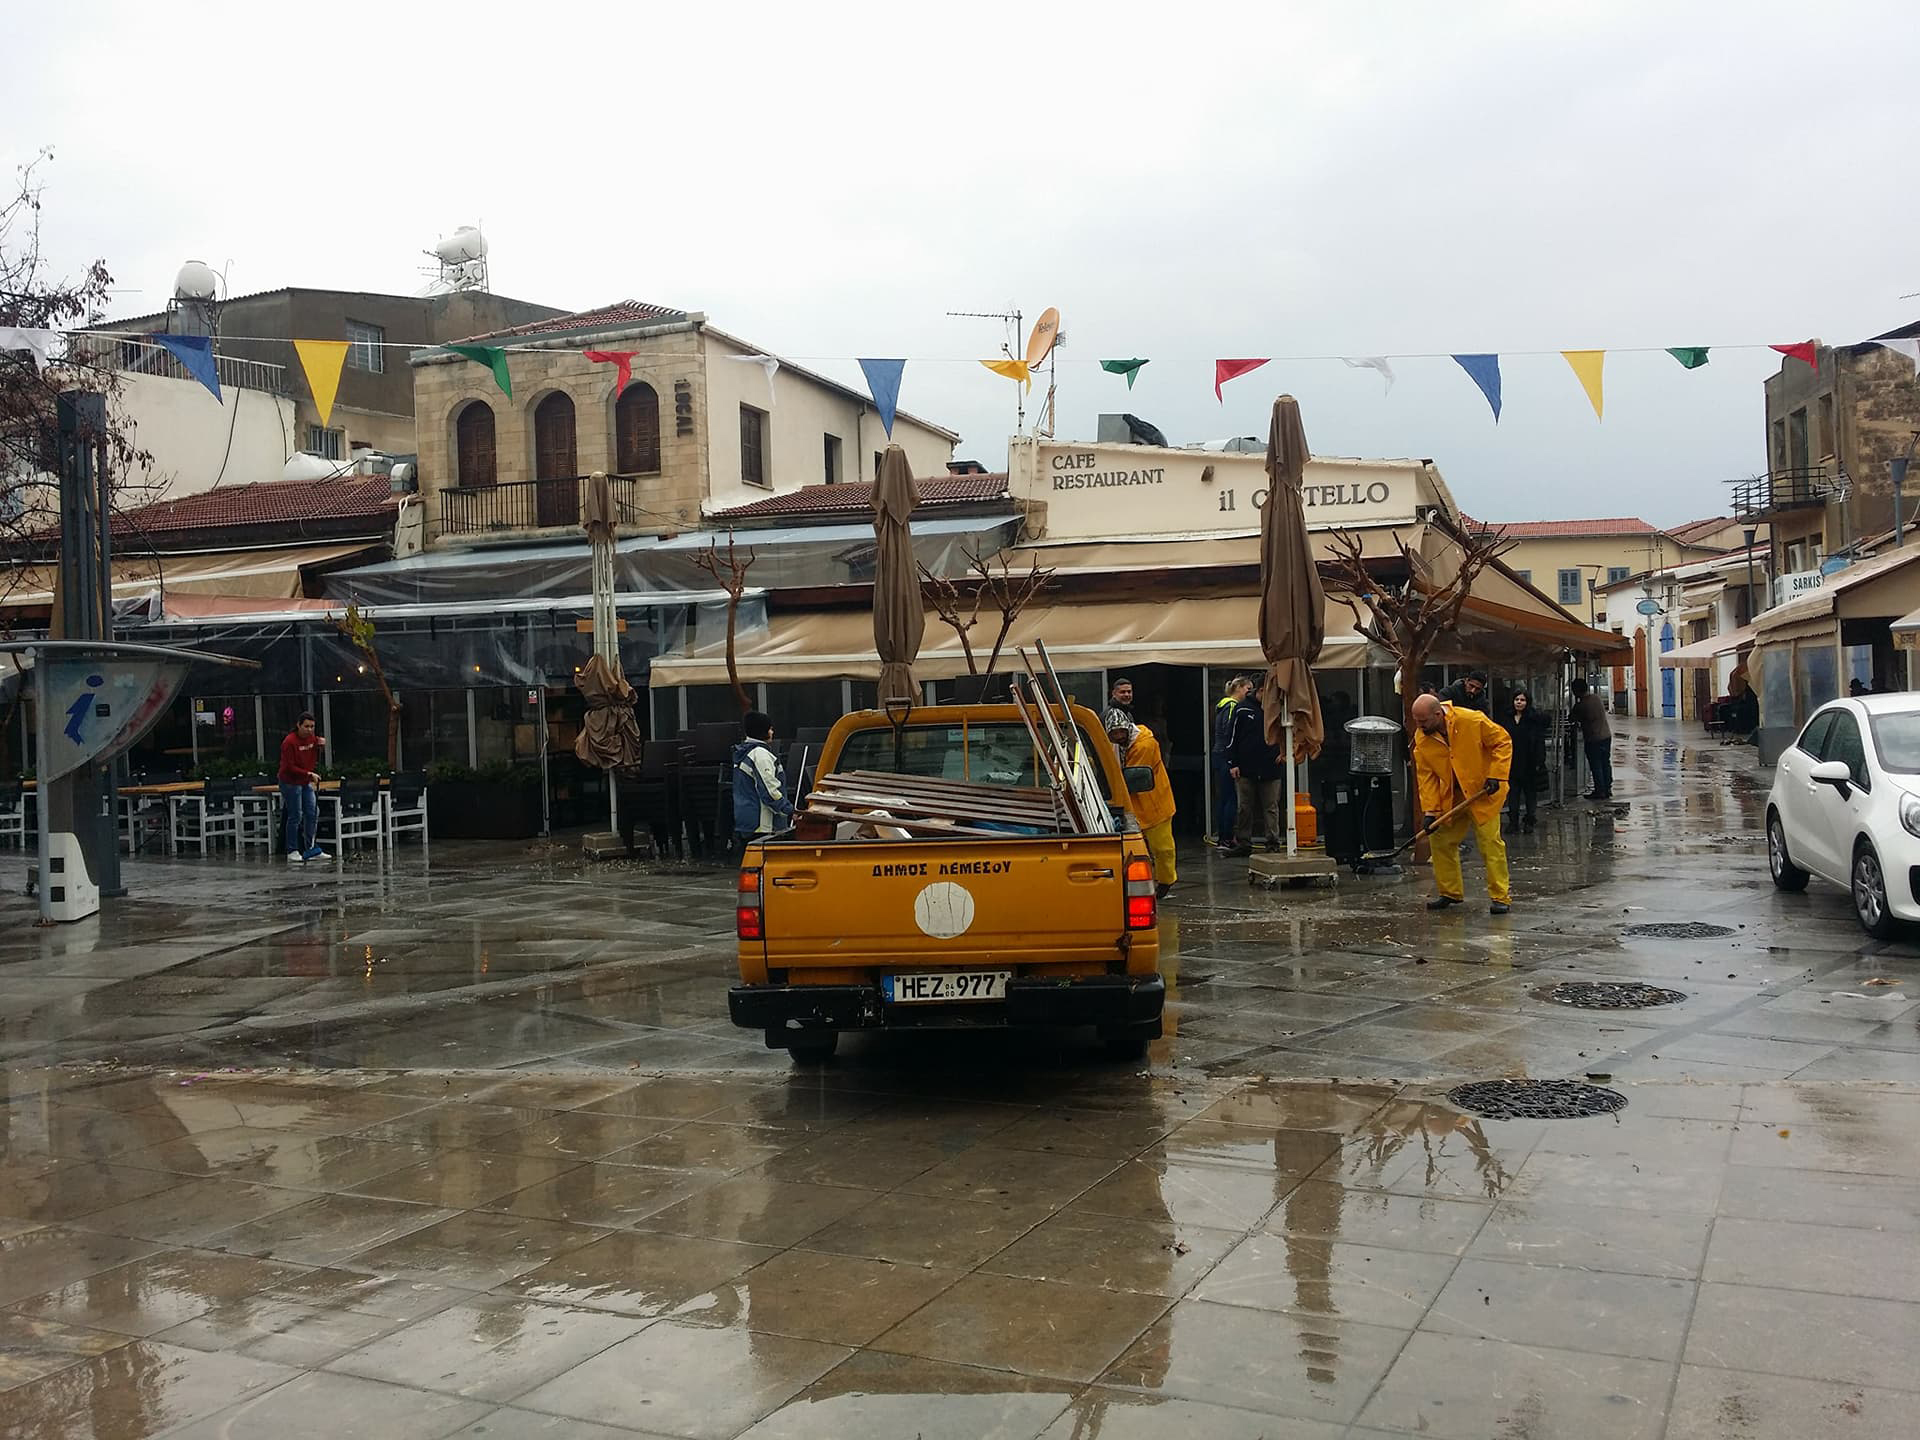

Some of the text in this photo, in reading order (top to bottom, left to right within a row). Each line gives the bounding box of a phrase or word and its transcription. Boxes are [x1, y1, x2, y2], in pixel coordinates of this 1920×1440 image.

[674, 382, 695, 438] LOCAL
[1052, 453, 1096, 470] CAFE
[1052, 468, 1165, 490] RESTAURANT
[1218, 482, 1390, 512] il CTELLO
[1792, 575, 1821, 591] SARKIS
[872, 860, 1012, 877] ΔΗΜΟΣ ΛΕΜΕΣΟΥ
[902, 974, 996, 998] HEZ 977
